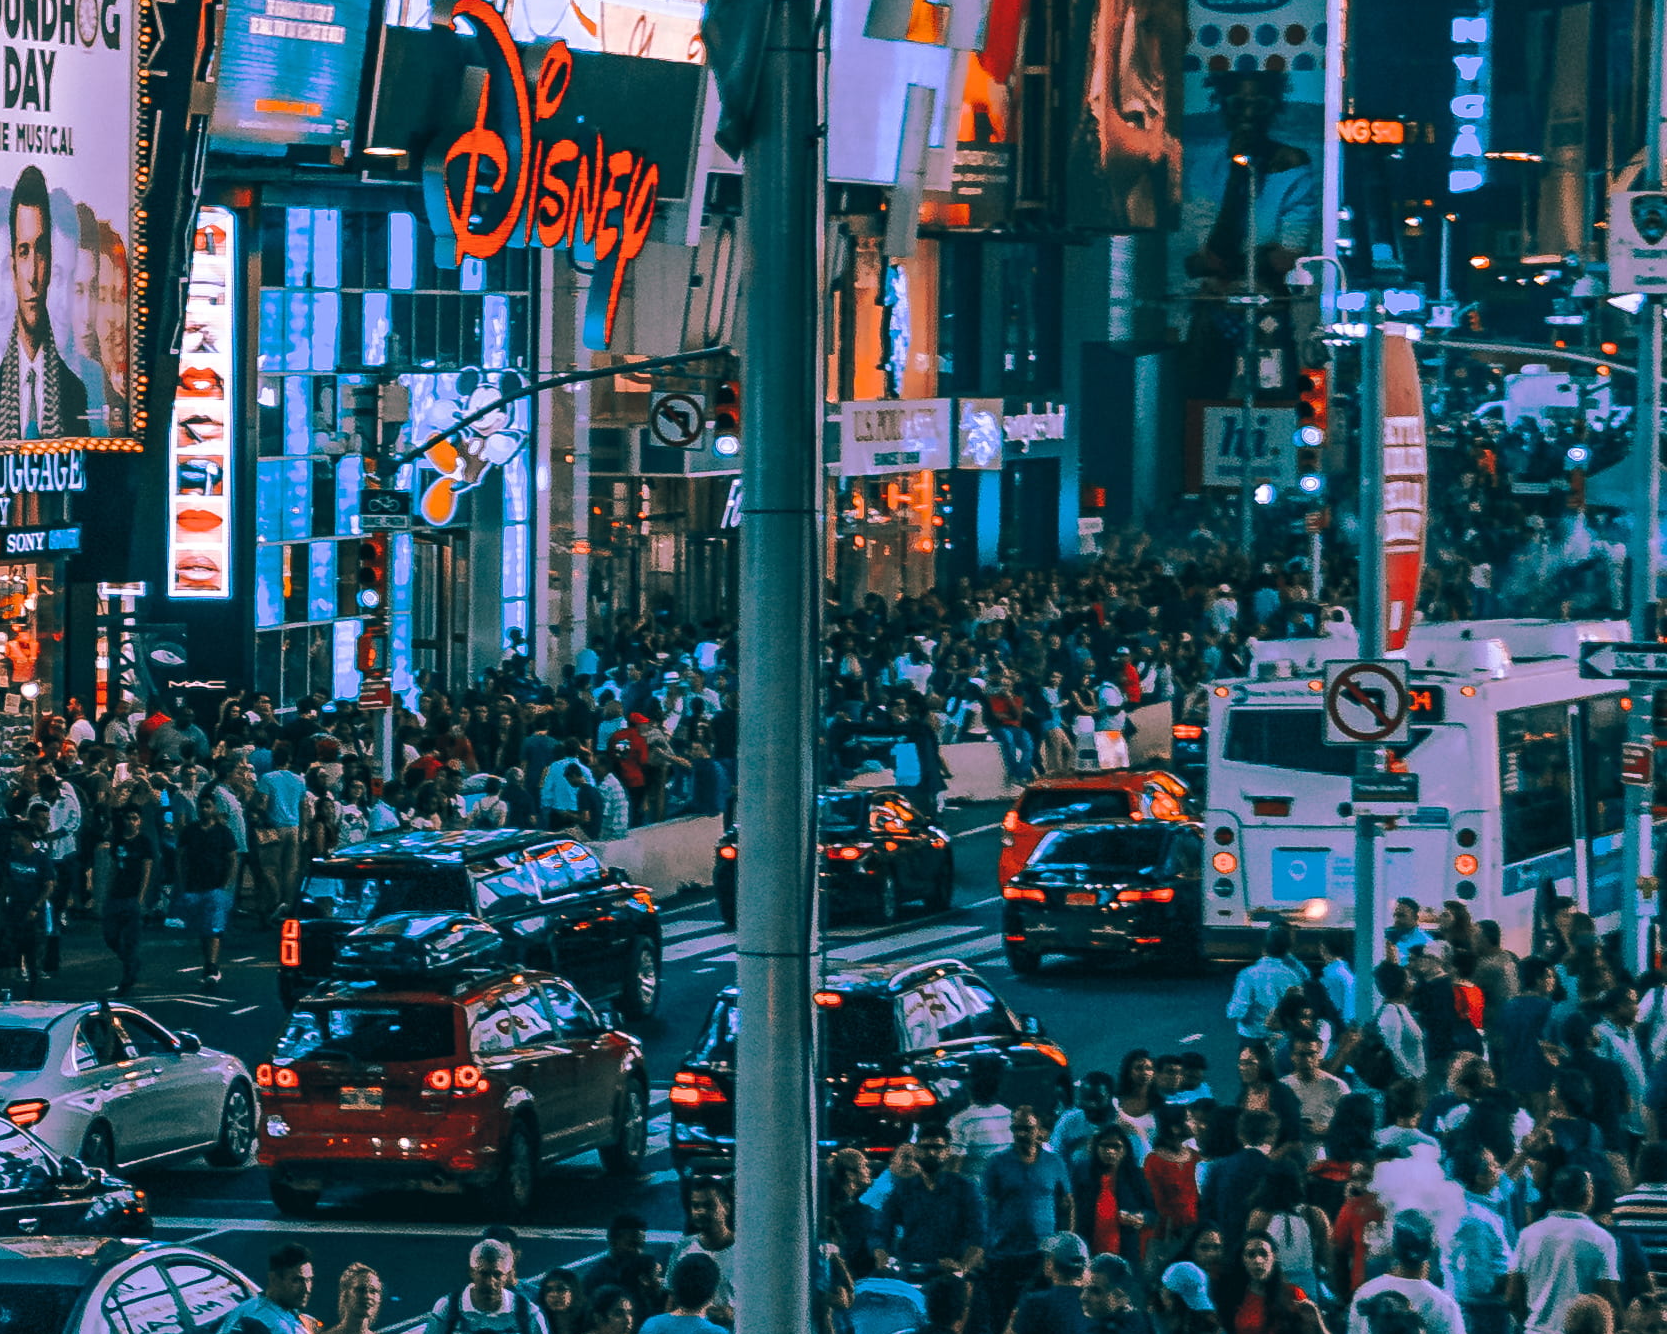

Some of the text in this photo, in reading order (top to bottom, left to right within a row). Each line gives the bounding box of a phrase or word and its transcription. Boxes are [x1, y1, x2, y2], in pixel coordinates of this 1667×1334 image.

[2, 51, 57, 113] DAY
[18, 121, 76, 157] MUSICAL
[6, 532, 46, 555] SONY
